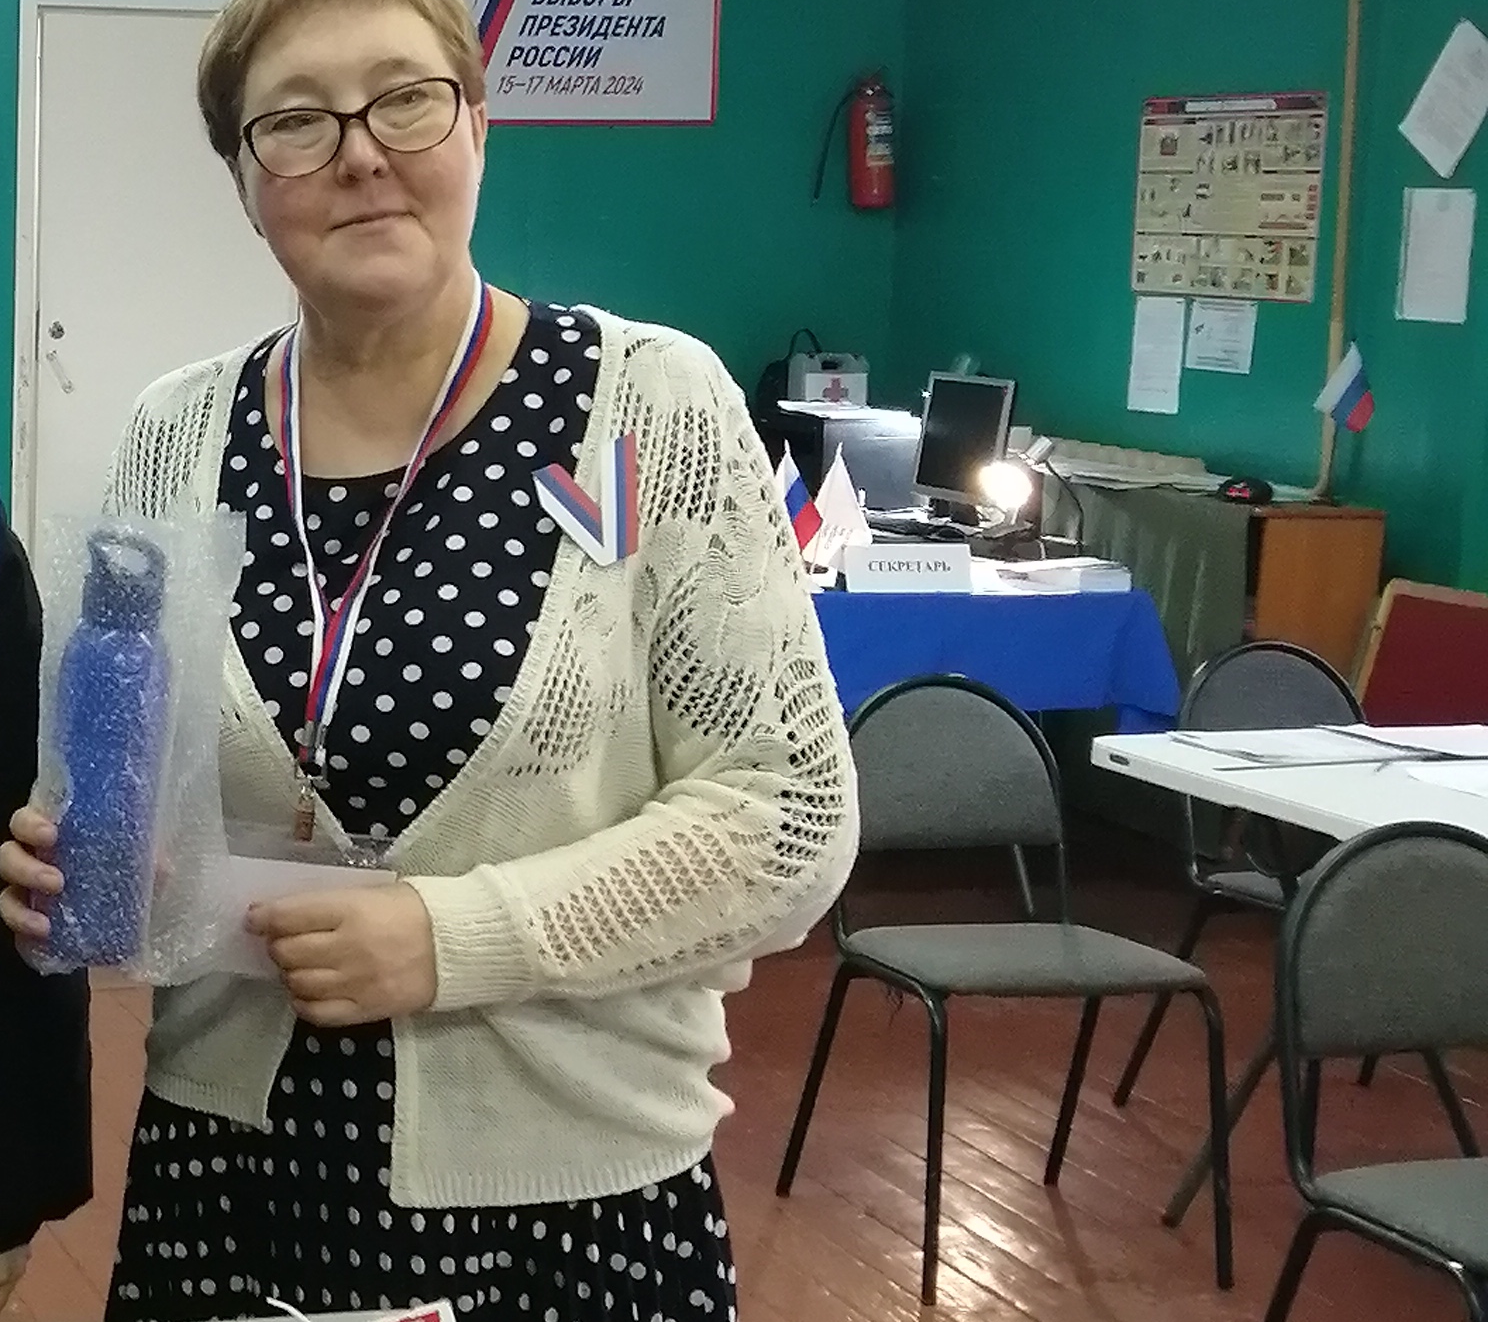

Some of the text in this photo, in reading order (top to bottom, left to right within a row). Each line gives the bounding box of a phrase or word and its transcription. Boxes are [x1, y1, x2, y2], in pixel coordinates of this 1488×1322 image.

[518, 15, 667, 40] ПРЕЗИДЕНТА
[506, 46, 603, 69] РОССИИ
[545, 76, 601, 95] МАРТА
[603, 76, 645, 95] 2024
[868, 560, 951, 573] СЕКРЕТАРЬ
